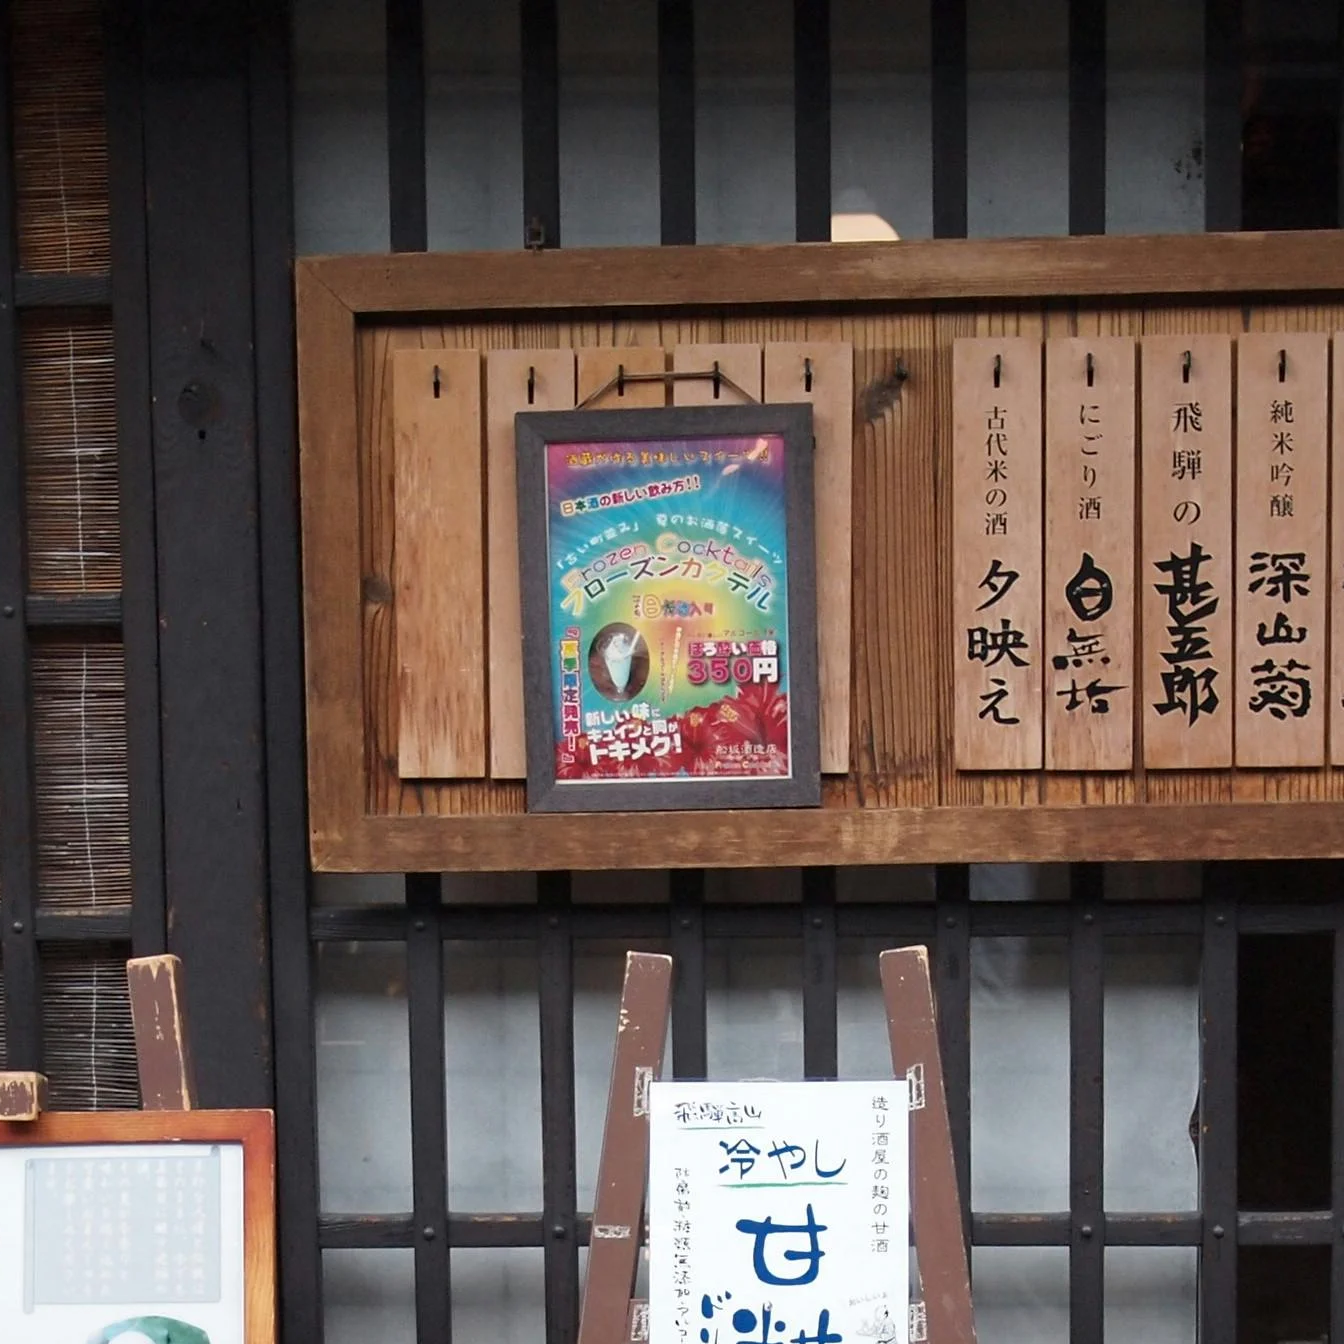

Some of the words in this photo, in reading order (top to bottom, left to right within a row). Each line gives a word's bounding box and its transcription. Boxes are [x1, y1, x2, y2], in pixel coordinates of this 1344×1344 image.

[984, 405, 1008, 535] 古代米の酒
[1078, 403, 1103, 520] にごり酒
[1172, 402, 1203, 525] 飛騨の
[1270, 399, 1294, 517] 純米吟醸
[688, 657, 778, 684] 350円
[967, 558, 1031, 725] 夕映え
[1152, 541, 1220, 728] 甚五郎
[1248, 551, 1312, 720] 深山菊
[585, 702, 661, 727] 新しい味に
[589, 733, 682, 765] トキメク!
[719, 1139, 847, 1179] 冷やし
